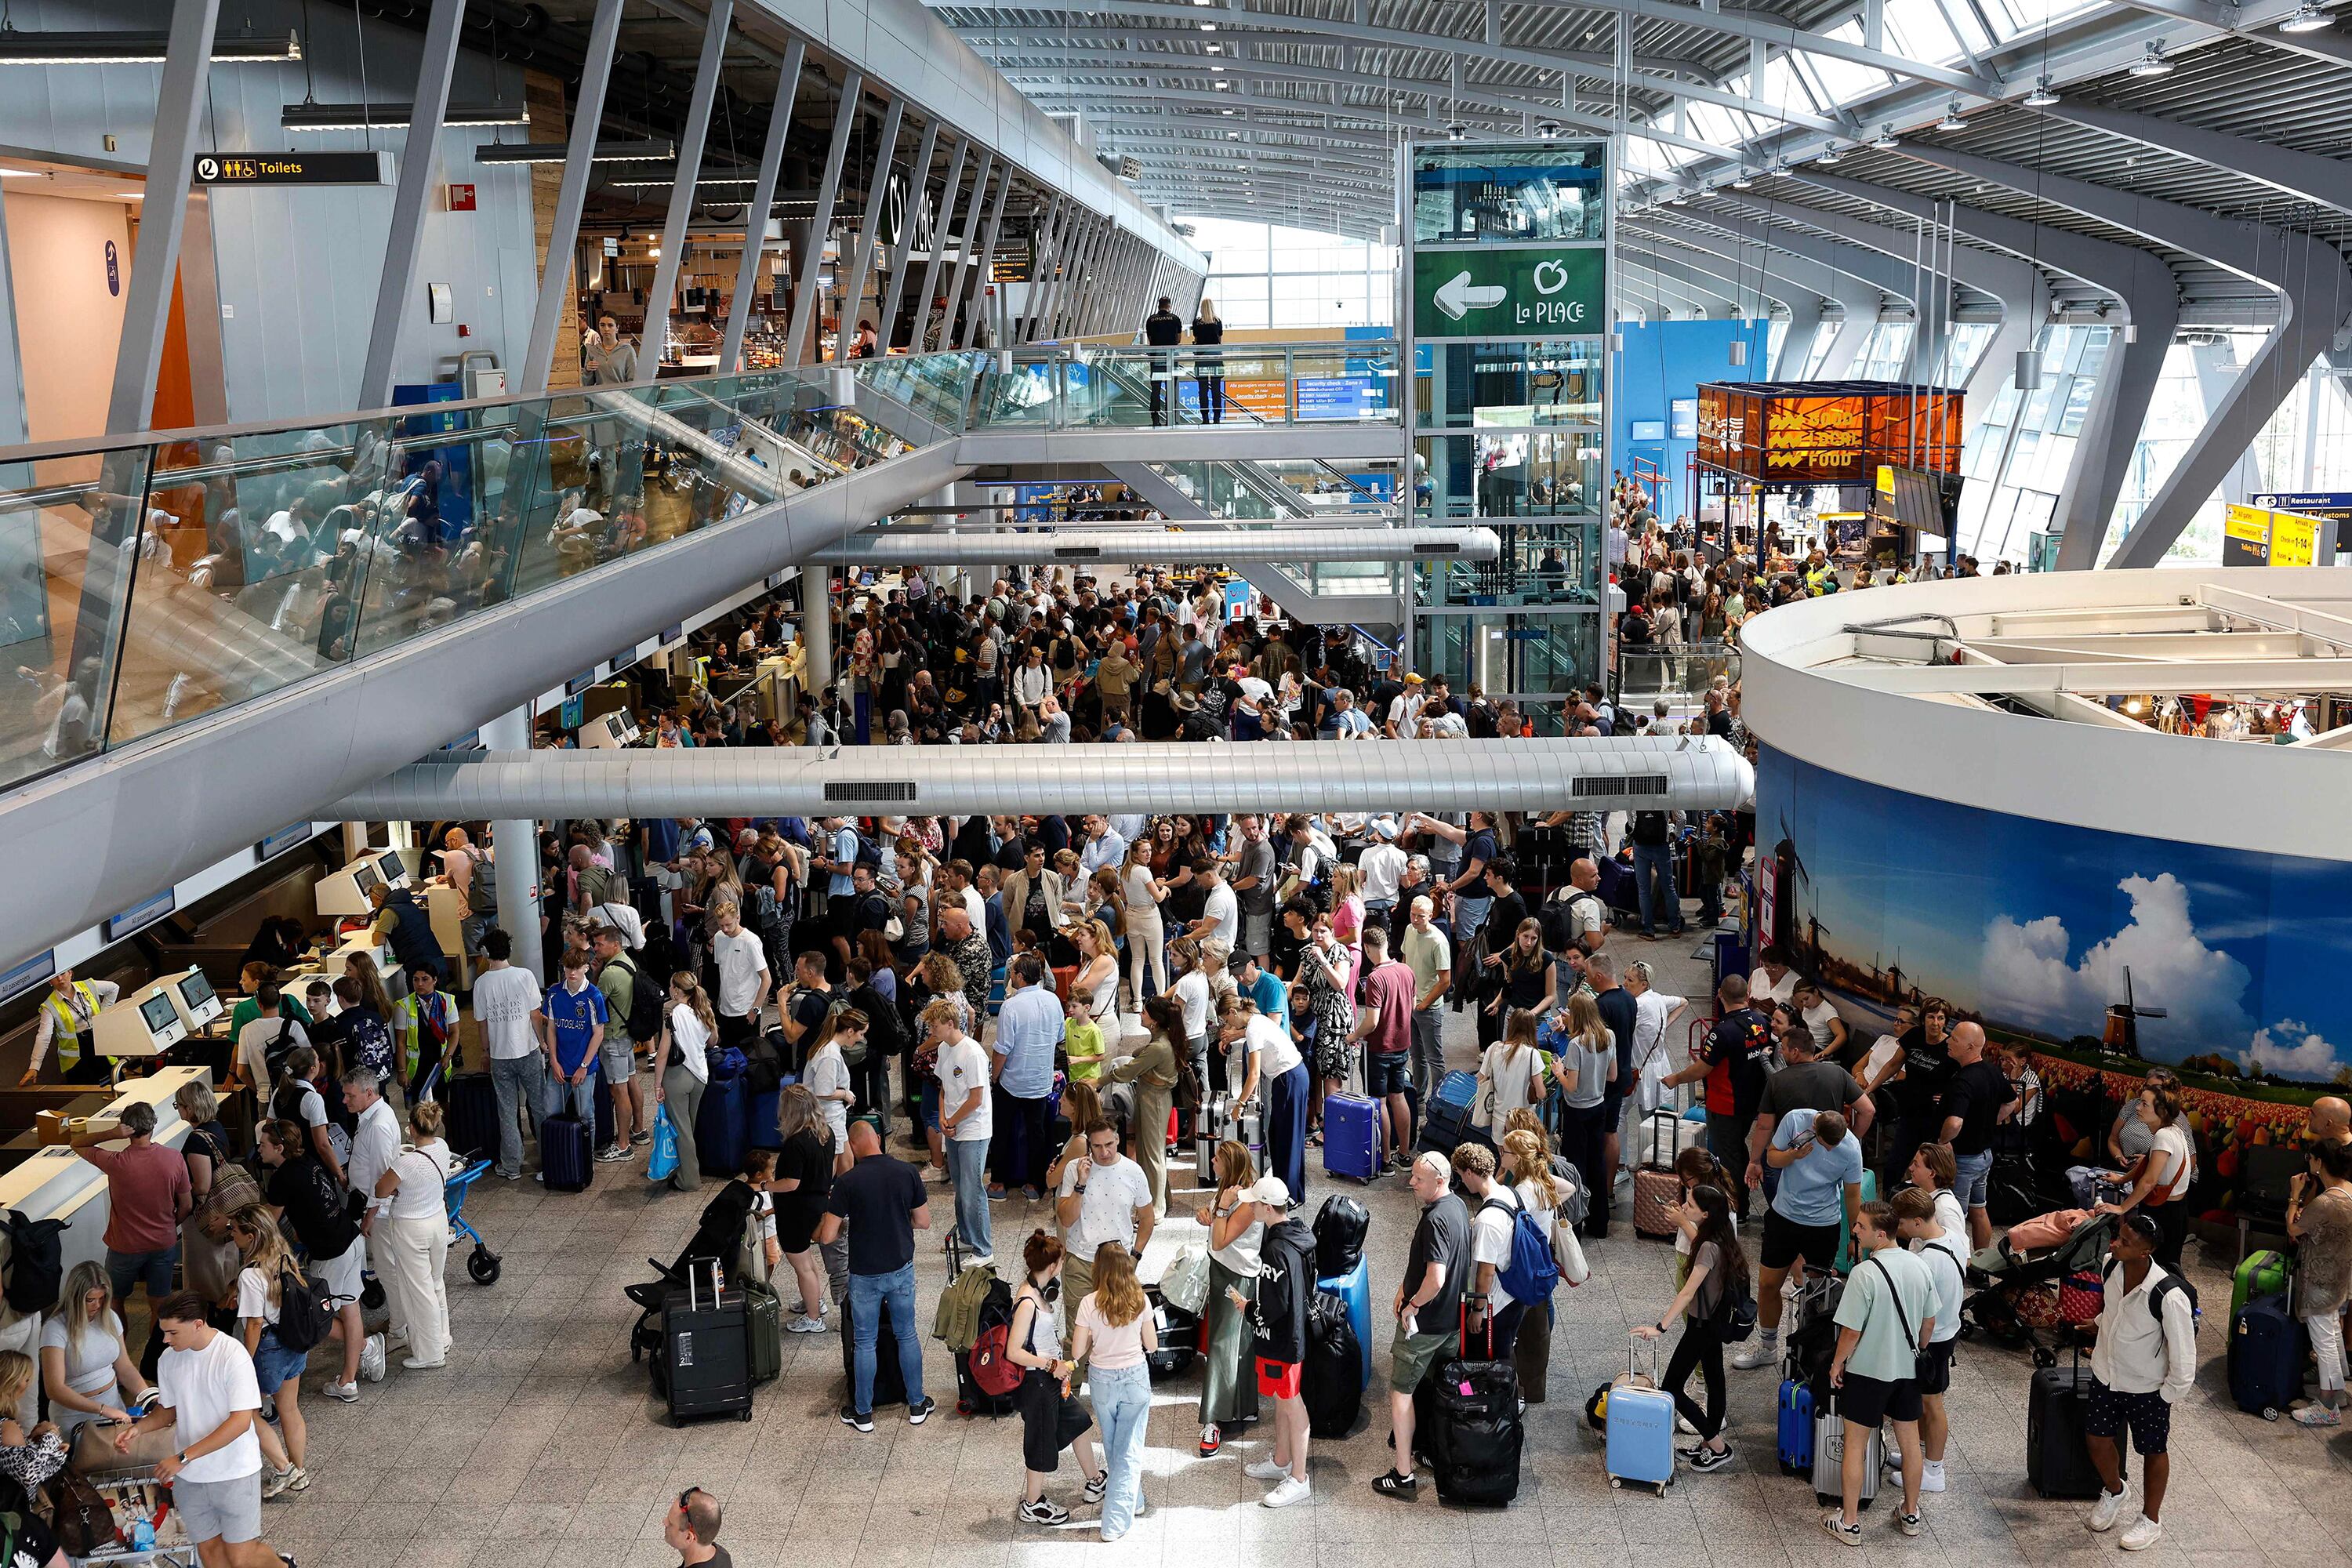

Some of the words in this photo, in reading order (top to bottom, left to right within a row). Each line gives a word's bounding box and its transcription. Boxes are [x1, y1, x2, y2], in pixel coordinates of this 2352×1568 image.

[260, 162, 303, 173] Toilets
[1516, 302, 1530, 324] La
[1536, 301, 1584, 323] PLACE
[1808, 413, 1853, 426] GOOD
[1809, 433, 1861, 445] LOCAL
[1809, 453, 1851, 466] FOOD
[2296, 537, 2307, 549] 1-14
[137, 909, 155, 922] passengers
[8, 975, 31, 990] passengers
[1910, 1048, 1940, 1065] Fabulous
[1918, 1061, 1935, 1072] classy
[1260, 1263, 1284, 1283] RY
[89, 1548, 128, 1556] Verdwaald.
